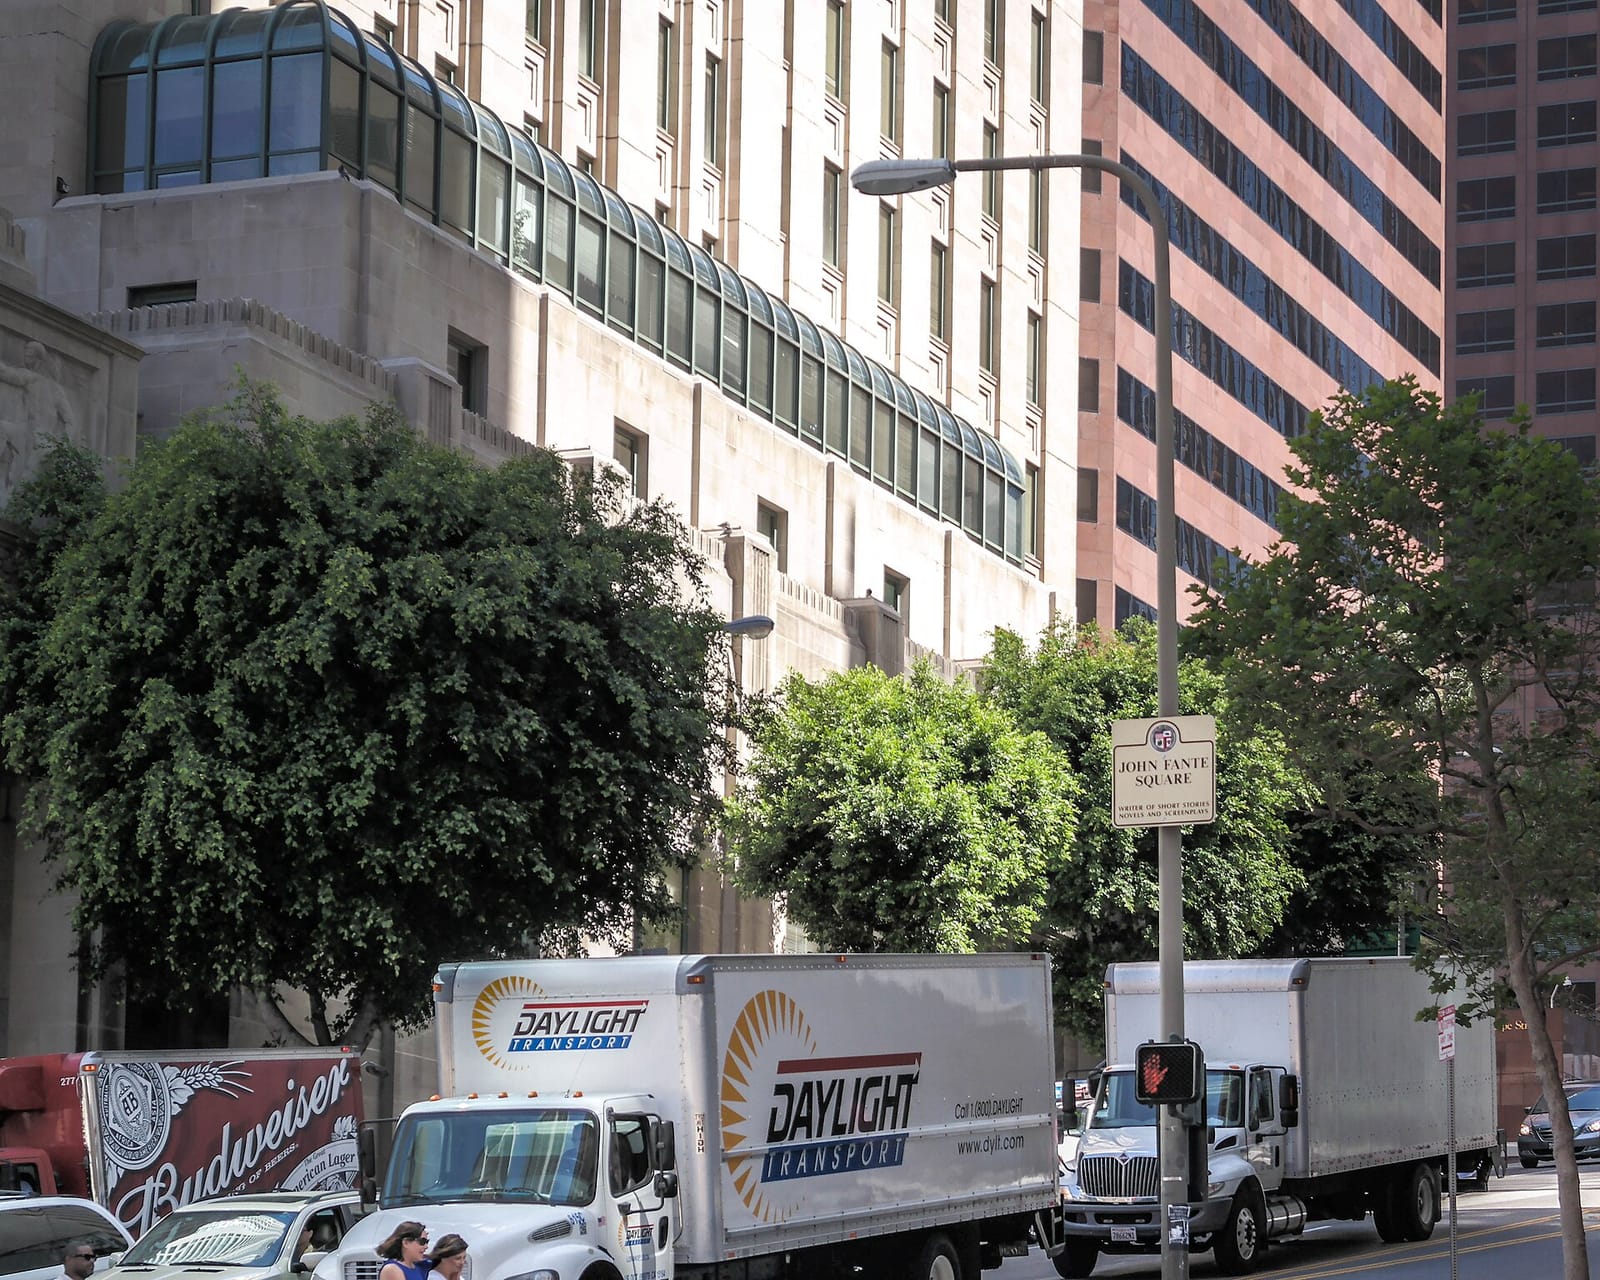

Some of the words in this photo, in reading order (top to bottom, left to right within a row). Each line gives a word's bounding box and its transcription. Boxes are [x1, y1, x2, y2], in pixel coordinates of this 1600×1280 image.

[1119, 759, 1157, 773] JOHN
[1164, 757, 1209, 771] FANTE
[1135, 772, 1192, 788] SQUARE
[1118, 804, 1143, 812] WRITER
[1146, 803, 1155, 811] OF
[1158, 802, 1180, 810] SHORT
[1119, 811, 1144, 819] NOVELS
[1164, 808, 1209, 816] SCREENPLAYS
[513, 1008, 647, 1036] DAYLIGHT
[512, 1036, 631, 1050] TRANSPORT
[765, 1073, 920, 1143] DAYLIGHT
[955, 1103, 968, 1119] Call
[115, 1058, 349, 1238] Budweiser
[958, 1135, 1024, 1155] www.dylt.com
[766, 1138, 904, 1178] TRANSPORT
[249, 1169, 262, 1184] OF
[293, 1160, 327, 1192] erican
[328, 1153, 356, 1168] Lager
